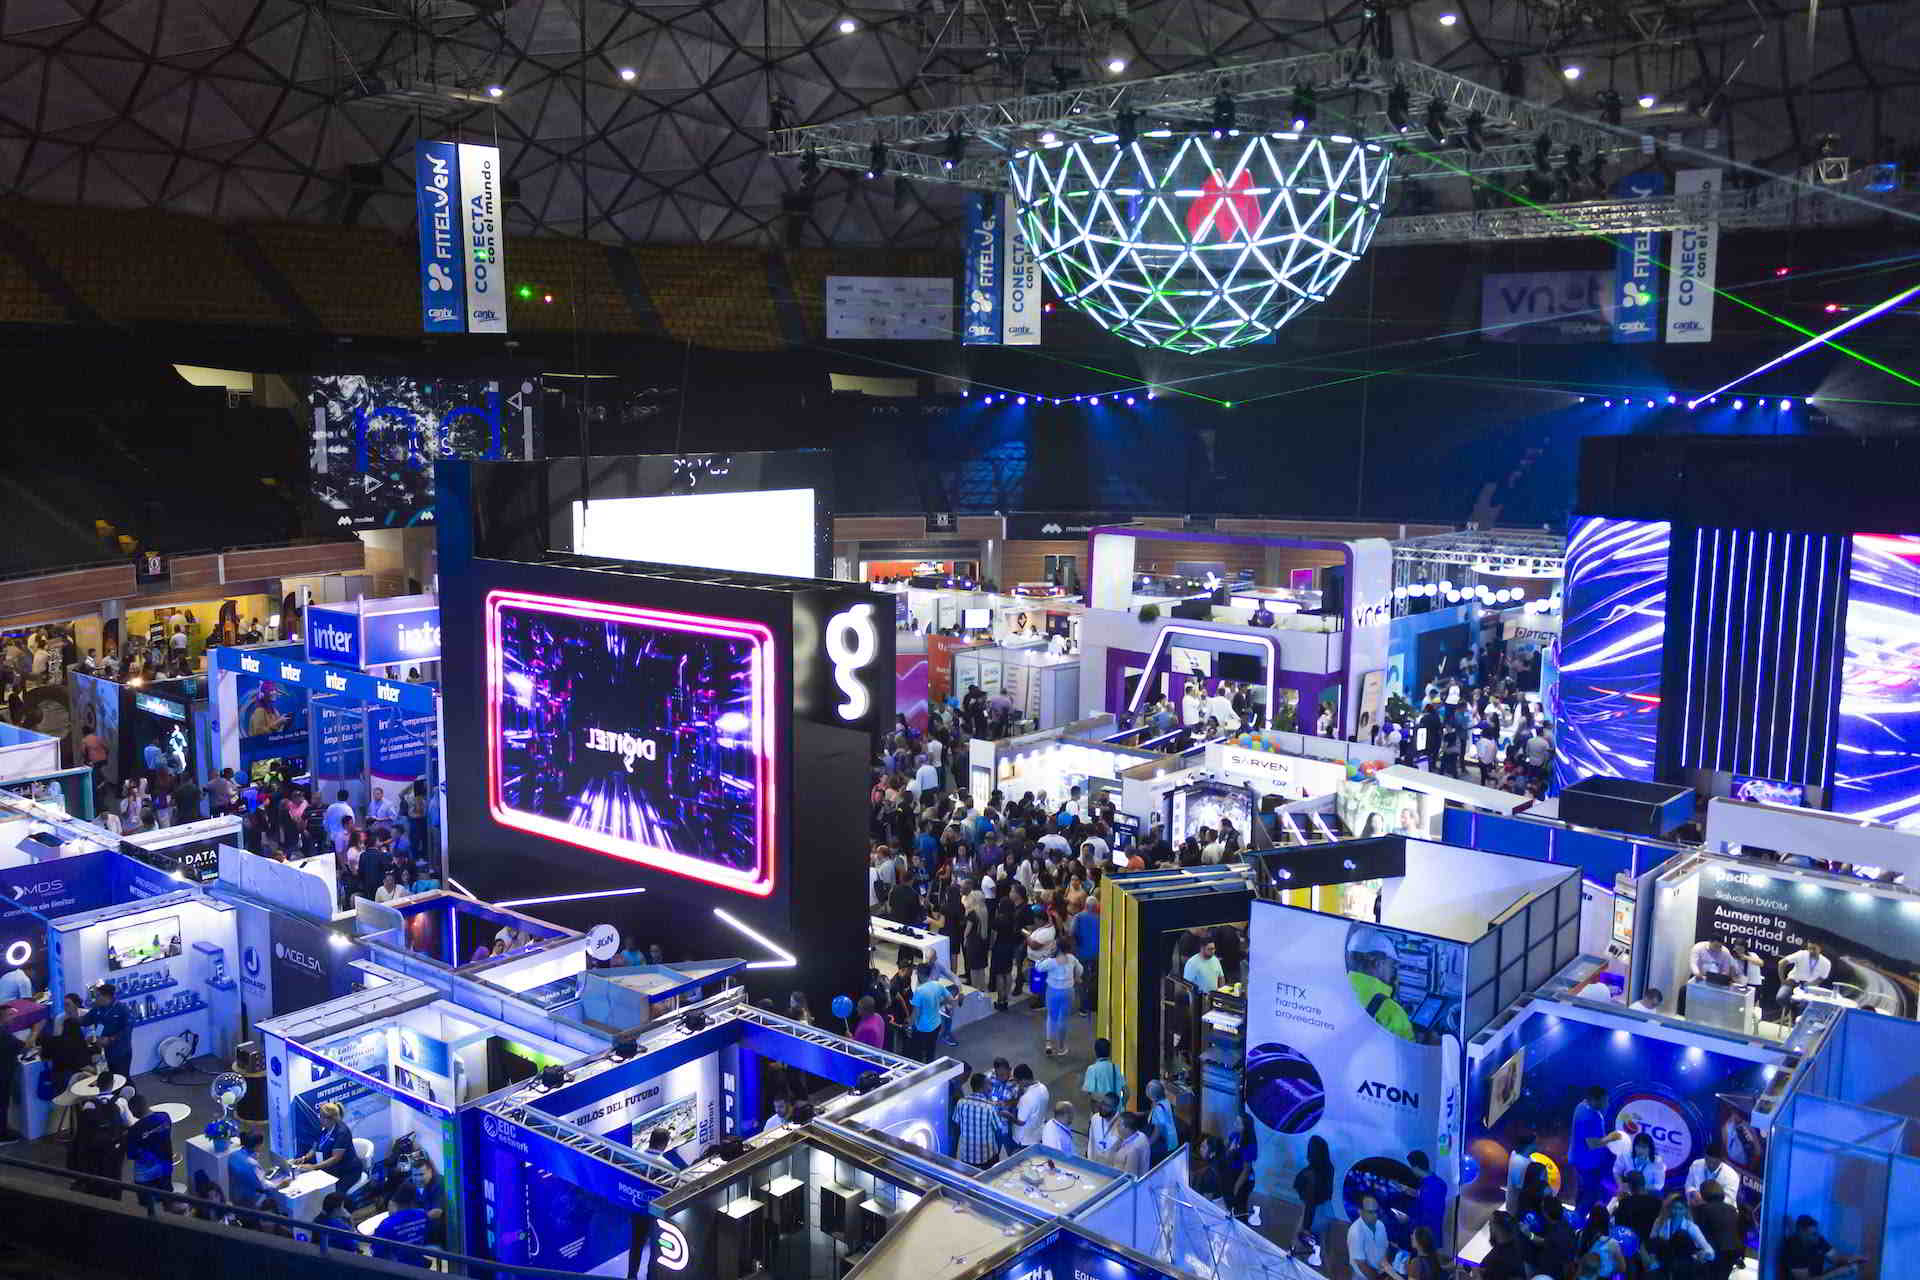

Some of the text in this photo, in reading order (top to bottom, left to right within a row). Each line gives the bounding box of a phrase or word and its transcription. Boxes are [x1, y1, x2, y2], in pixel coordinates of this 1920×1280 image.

[482, 160, 496, 264] con el mundo
[471, 194, 487, 293] CONECTA
[1679, 229, 1697, 306] CONECT
[313, 622, 353, 653] inter
[240, 653, 261, 673] inter
[280, 662, 302, 682] inter
[325, 670, 348, 692] inter
[376, 680, 401, 703] inter
[185, 849, 217, 865] DATA
[1715, 905, 1786, 929] Aumente la
[1714, 921, 1783, 942] capacidad
[1786, 934, 1804, 946] de
[1755, 940, 1779, 956] hoy
[1357, 1080, 1419, 1108] ATON
[576, 1108, 605, 1127] HILOS
[606, 1101, 624, 1115] DEL
